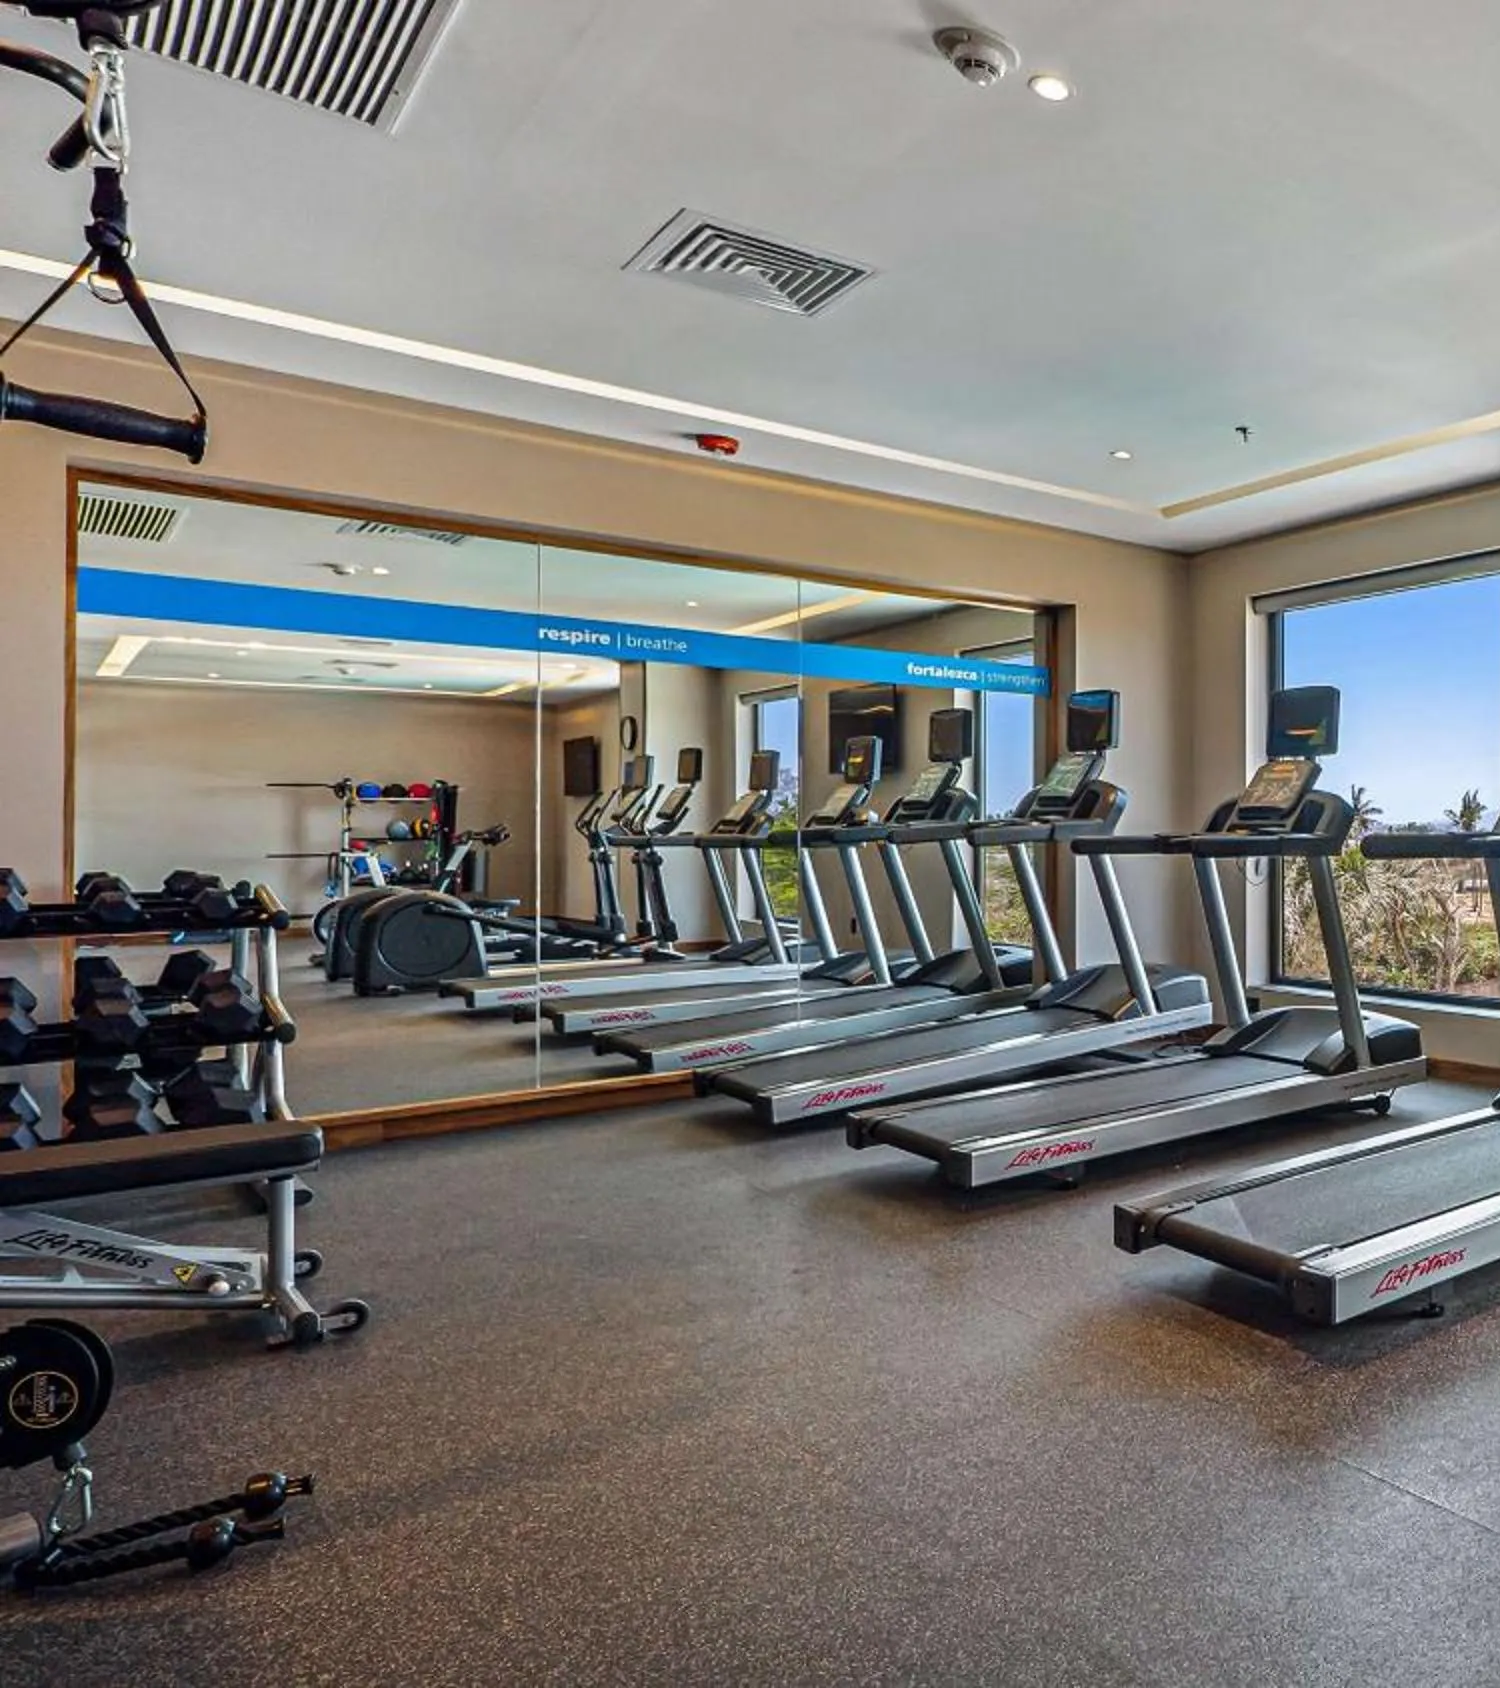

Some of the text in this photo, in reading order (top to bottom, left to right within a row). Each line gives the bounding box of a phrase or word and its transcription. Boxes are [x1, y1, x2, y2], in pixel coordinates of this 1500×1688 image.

[538, 627, 688, 653] respire breathe
[906, 661, 977, 682] fortalezca
